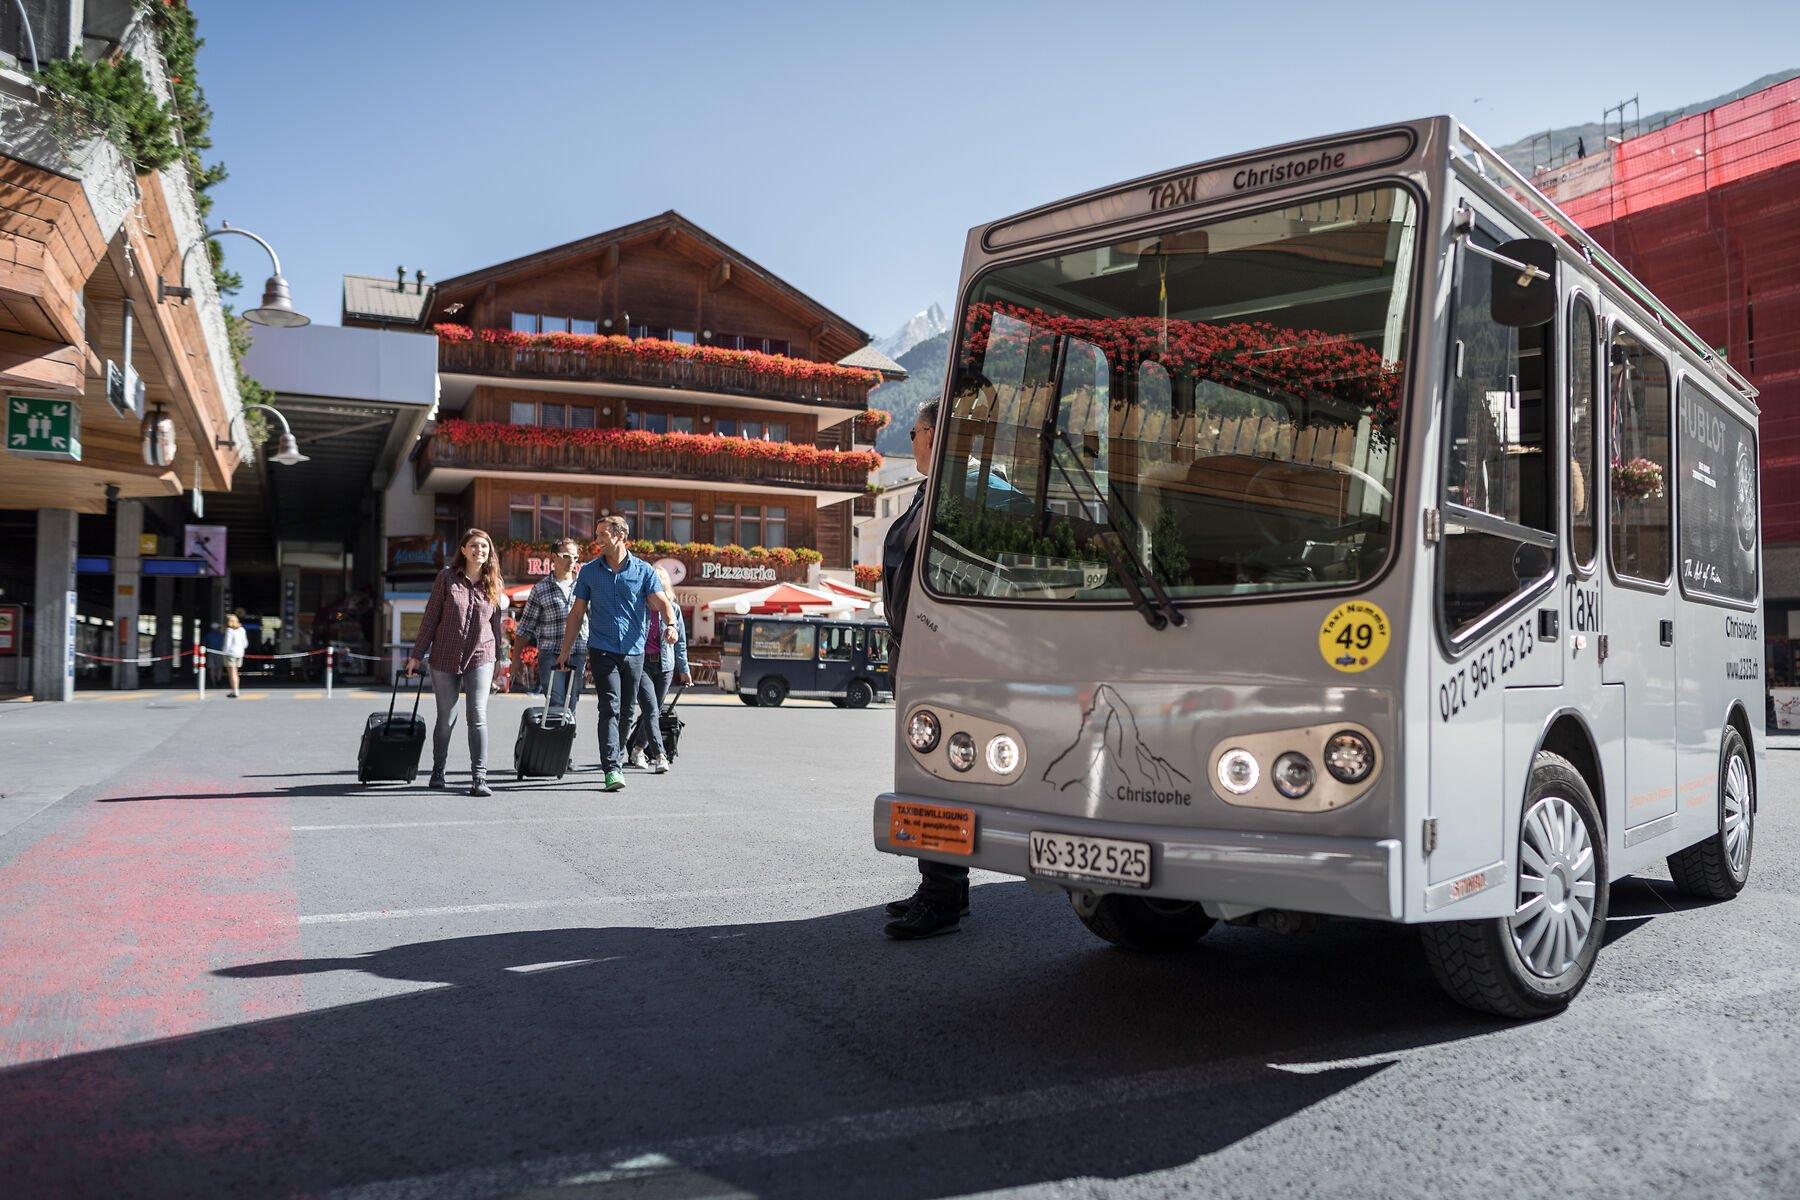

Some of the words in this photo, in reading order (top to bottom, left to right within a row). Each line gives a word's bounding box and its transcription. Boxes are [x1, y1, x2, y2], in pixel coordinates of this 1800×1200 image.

[1149, 176, 1198, 211] TAXI
[1233, 152, 1345, 190] Christophe
[702, 562, 777, 581] Pizzeria
[1565, 574, 1599, 632] Taxi
[917, 612, 938, 633] JONAS
[1323, 609, 1344, 634] Taxi
[1725, 616, 1758, 641] Christophe
[1335, 623, 1373, 650] 49
[1440, 669, 1467, 723] 027
[1471, 647, 1496, 699] 967
[1500, 632, 1516, 676] 23
[1518, 619, 1534, 660] 23
[1117, 785, 1192, 806] Christophe
[897, 805, 969, 821] TAXIBEWILLIGUNG
